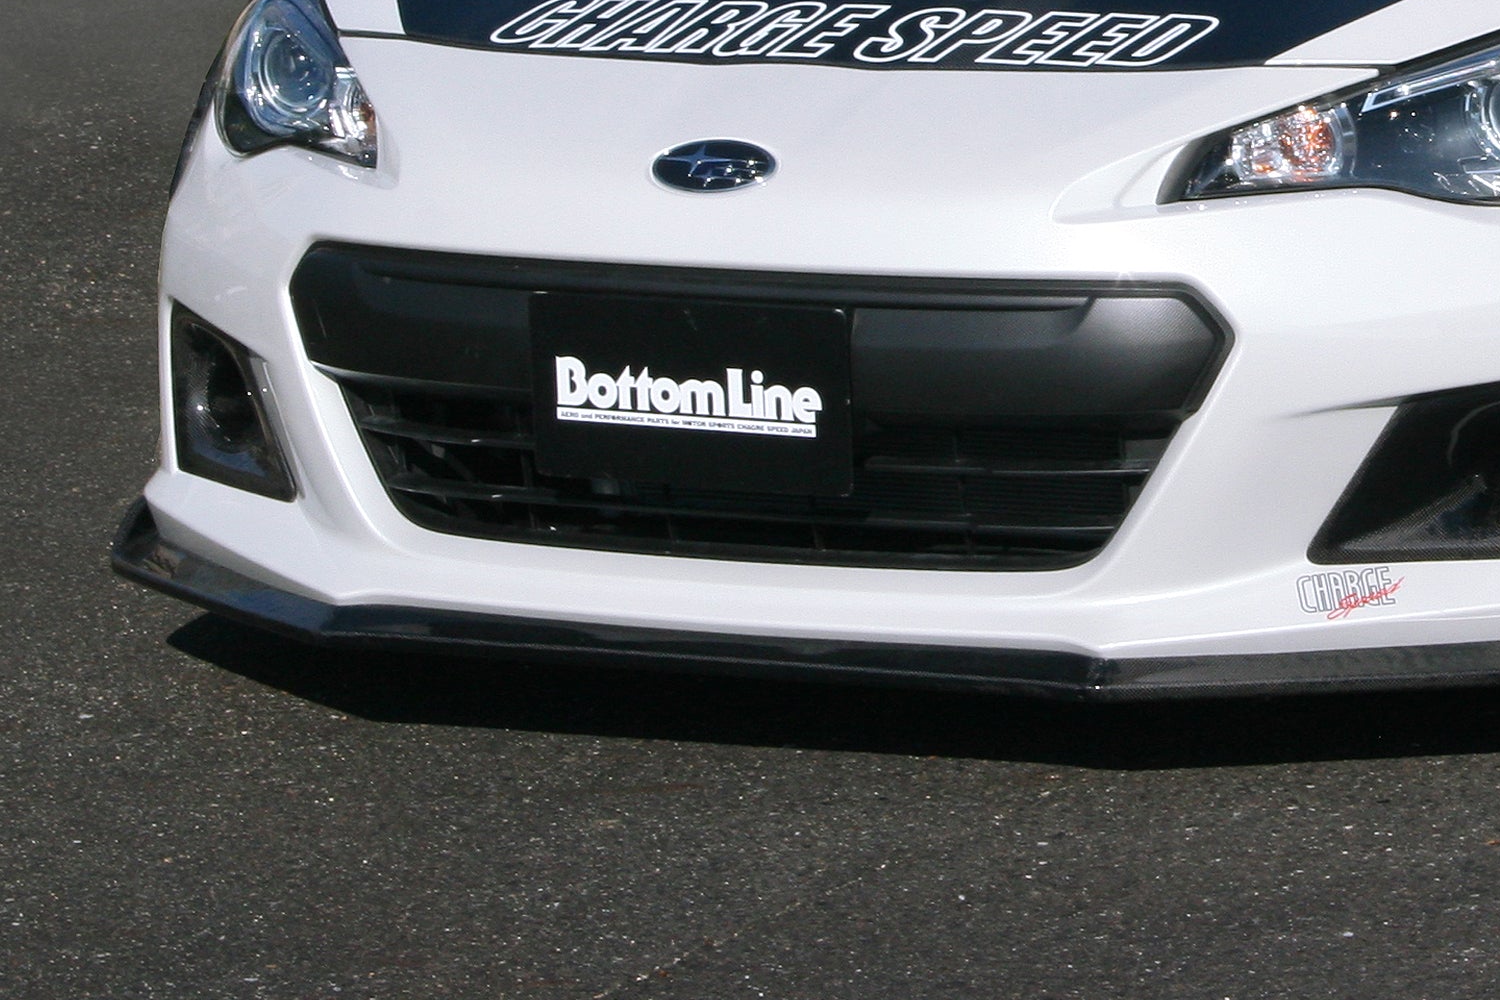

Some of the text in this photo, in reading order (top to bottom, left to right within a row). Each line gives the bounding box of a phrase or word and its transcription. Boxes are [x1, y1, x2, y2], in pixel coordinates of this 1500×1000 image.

[853, 7, 1220, 67] SPEED
[555, 355, 824, 424] BottomLine
[1295, 565, 1397, 614] CHARGE
